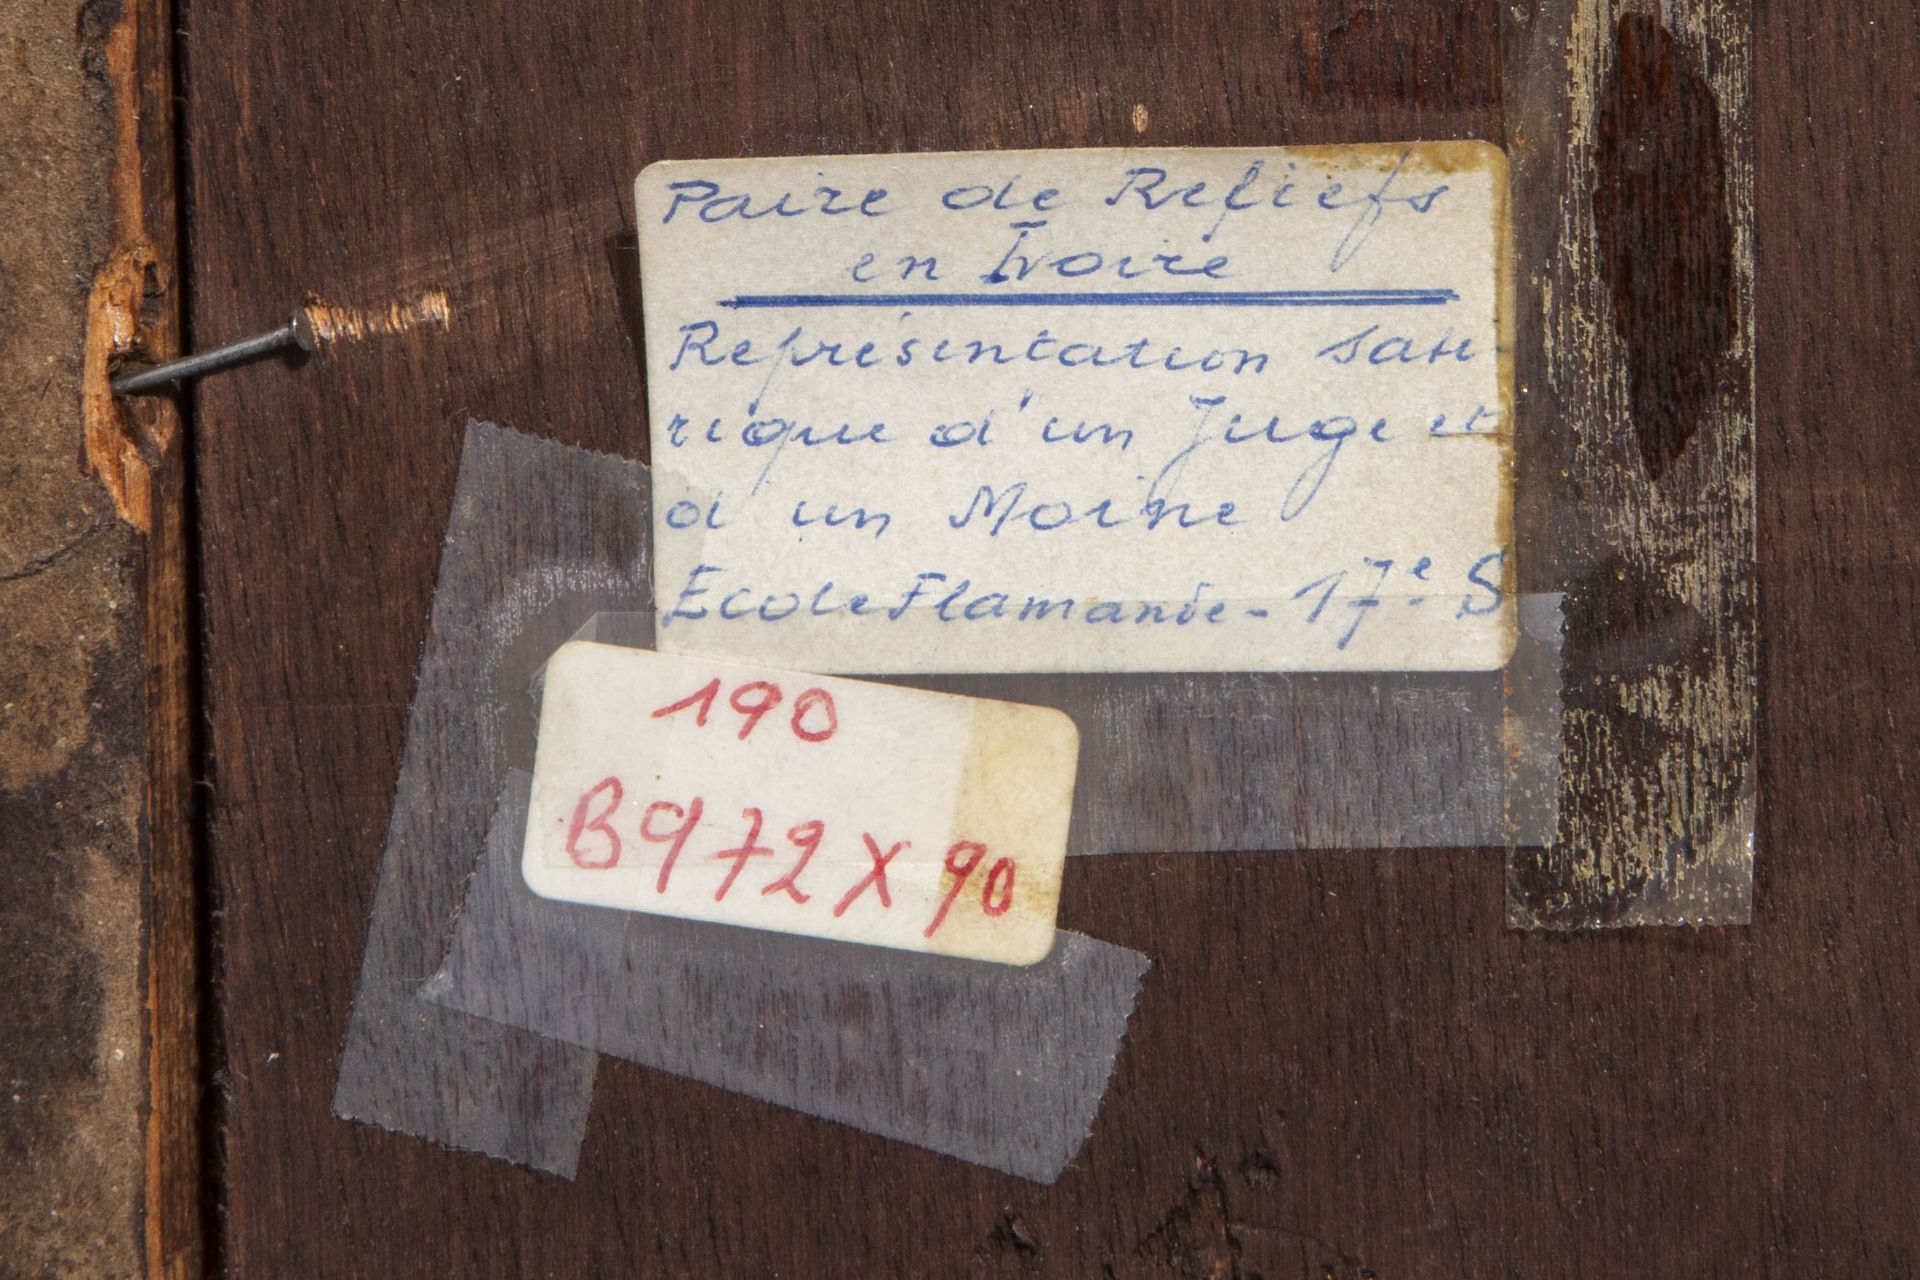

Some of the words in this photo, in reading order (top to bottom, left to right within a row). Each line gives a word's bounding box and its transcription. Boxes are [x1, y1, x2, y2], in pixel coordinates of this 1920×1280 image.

[663, 174, 897, 224] Paire
[942, 173, 1071, 212] de
[1105, 148, 1449, 272] Reliefs
[848, 252, 944, 282] en
[980, 220, 1230, 284] Ivoire
[667, 412, 898, 495] rique
[930, 390, 1132, 449] d'un
[1147, 394, 1394, 522] Juge
[1429, 404, 1508, 438] et
[949, 475, 1246, 537] Moine
[1455, 549, 1508, 619] S
[651, 678, 838, 742] 190
